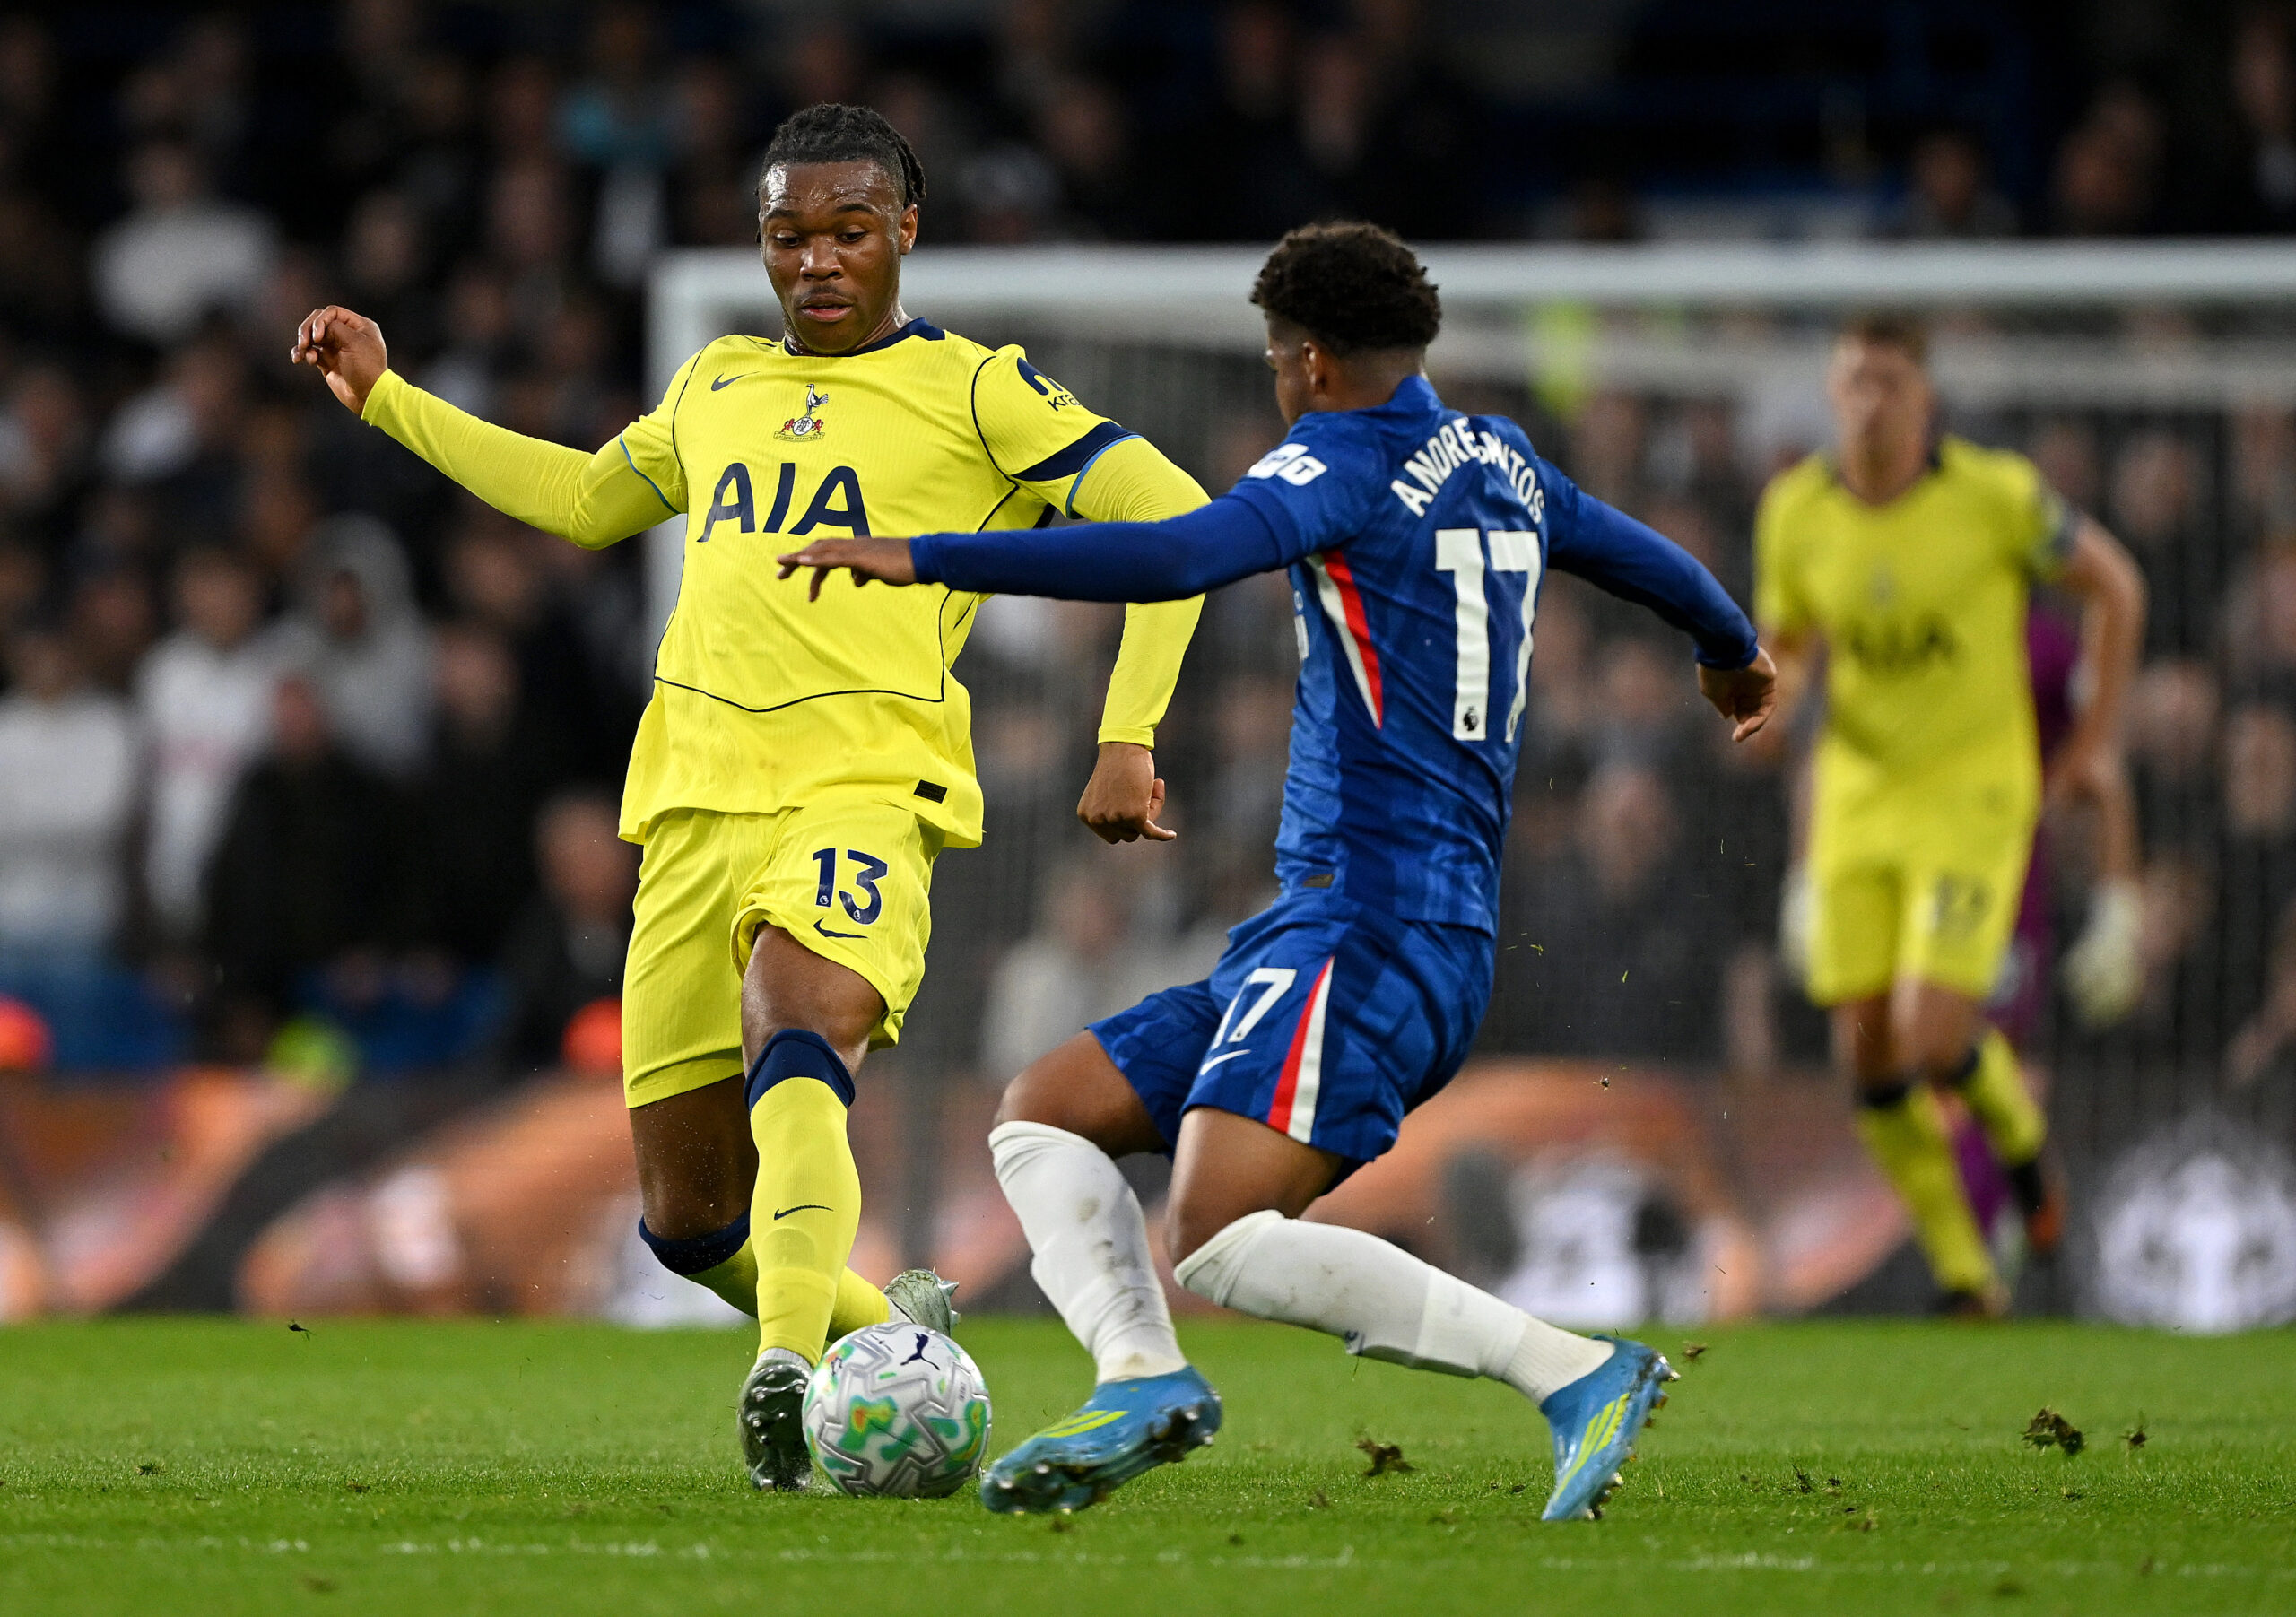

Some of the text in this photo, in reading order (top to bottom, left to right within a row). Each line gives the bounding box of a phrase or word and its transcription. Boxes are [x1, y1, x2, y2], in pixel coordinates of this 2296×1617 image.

[696, 462, 872, 543] AIA
[1435, 527, 1542, 744] 17
[812, 848, 888, 925] 13
